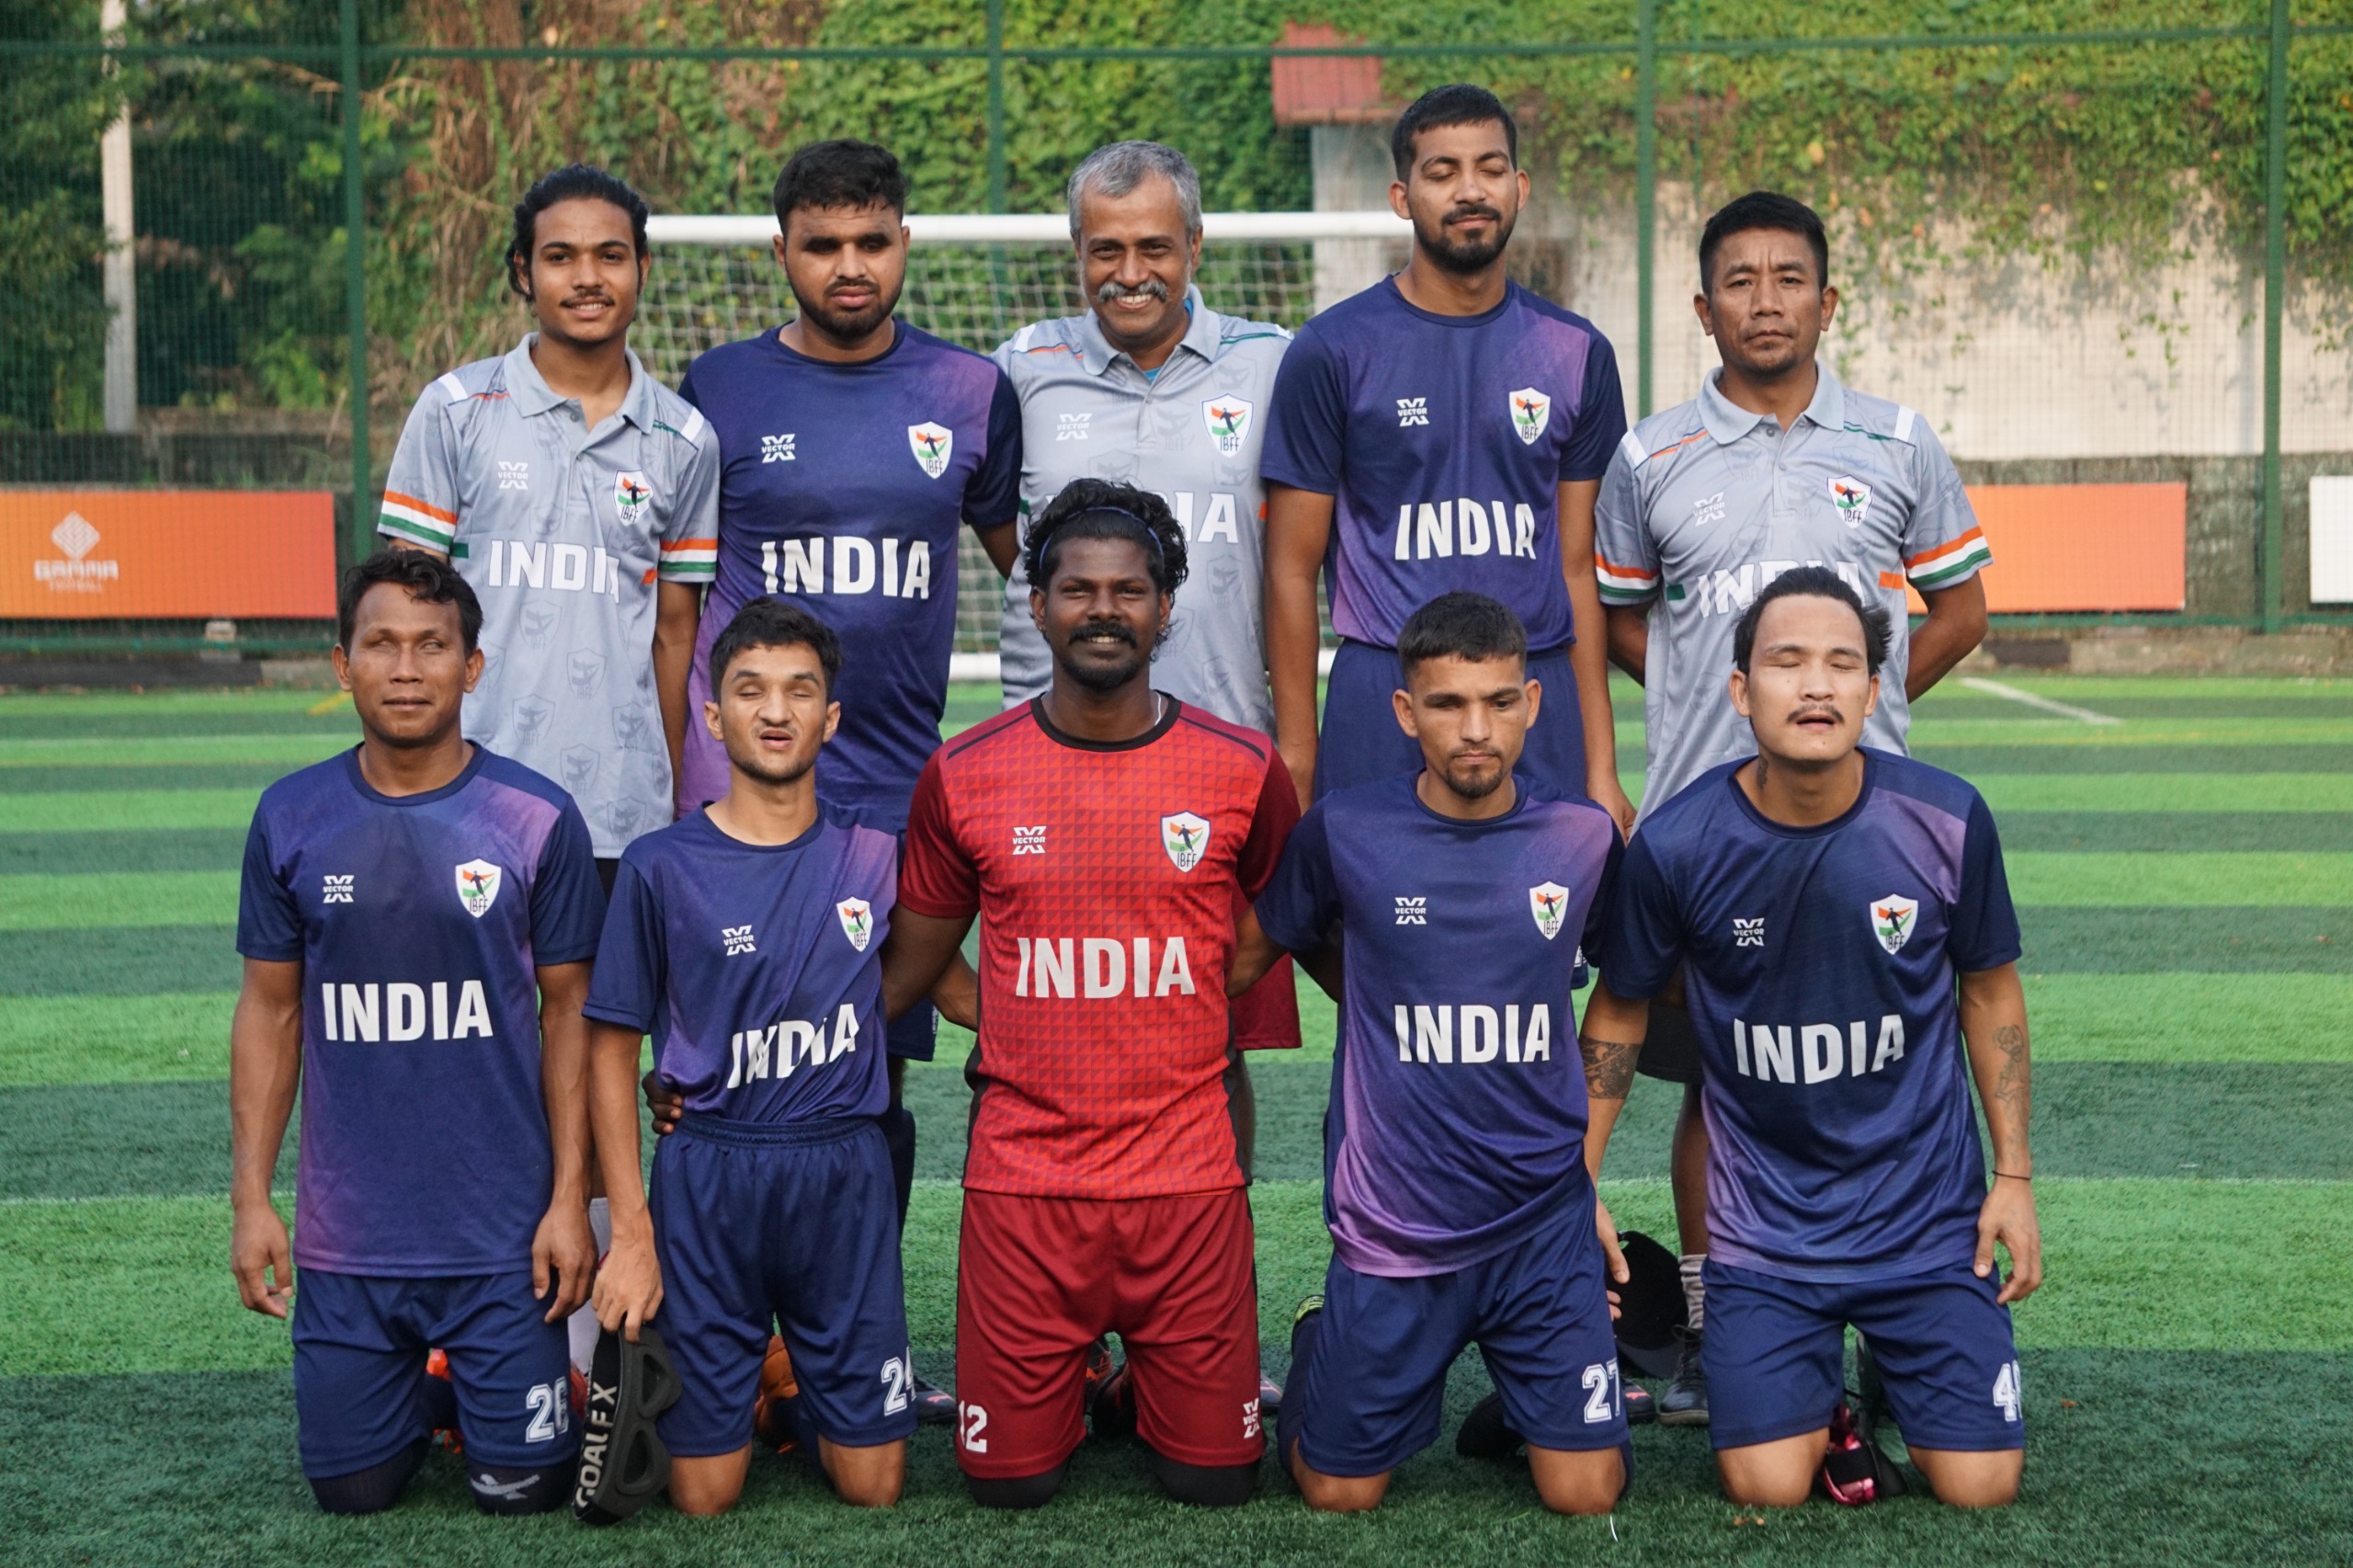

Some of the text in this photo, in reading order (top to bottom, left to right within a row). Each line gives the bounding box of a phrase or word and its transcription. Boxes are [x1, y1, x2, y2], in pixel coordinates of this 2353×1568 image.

[1521, 426, 1539, 440] IBFF
[1220, 437, 1240, 451] IBFF
[926, 459, 944, 476] IBFF
[1843, 508, 1863, 523] IBFF
[1394, 497, 1537, 560] INDIA
[762, 536, 930, 599] INDIA
[1013, 835, 1047, 845] VECTOR
[1176, 852, 1197, 869] IBFF
[323, 884, 355, 893] VECTOR
[468, 896, 489, 913] IBFF
[1394, 906, 1427, 915] VECTOR
[1542, 919, 1561, 937] IBFF
[723, 934, 756, 946] VECTOR
[853, 932, 869, 949] IBFF
[1016, 936, 1196, 998] INDIA
[322, 980, 494, 1042] INDIA
[1394, 1004, 1551, 1064] INDIA
[726, 1003, 860, 1089] INDIA
[1733, 1014, 1905, 1085] INDIA
